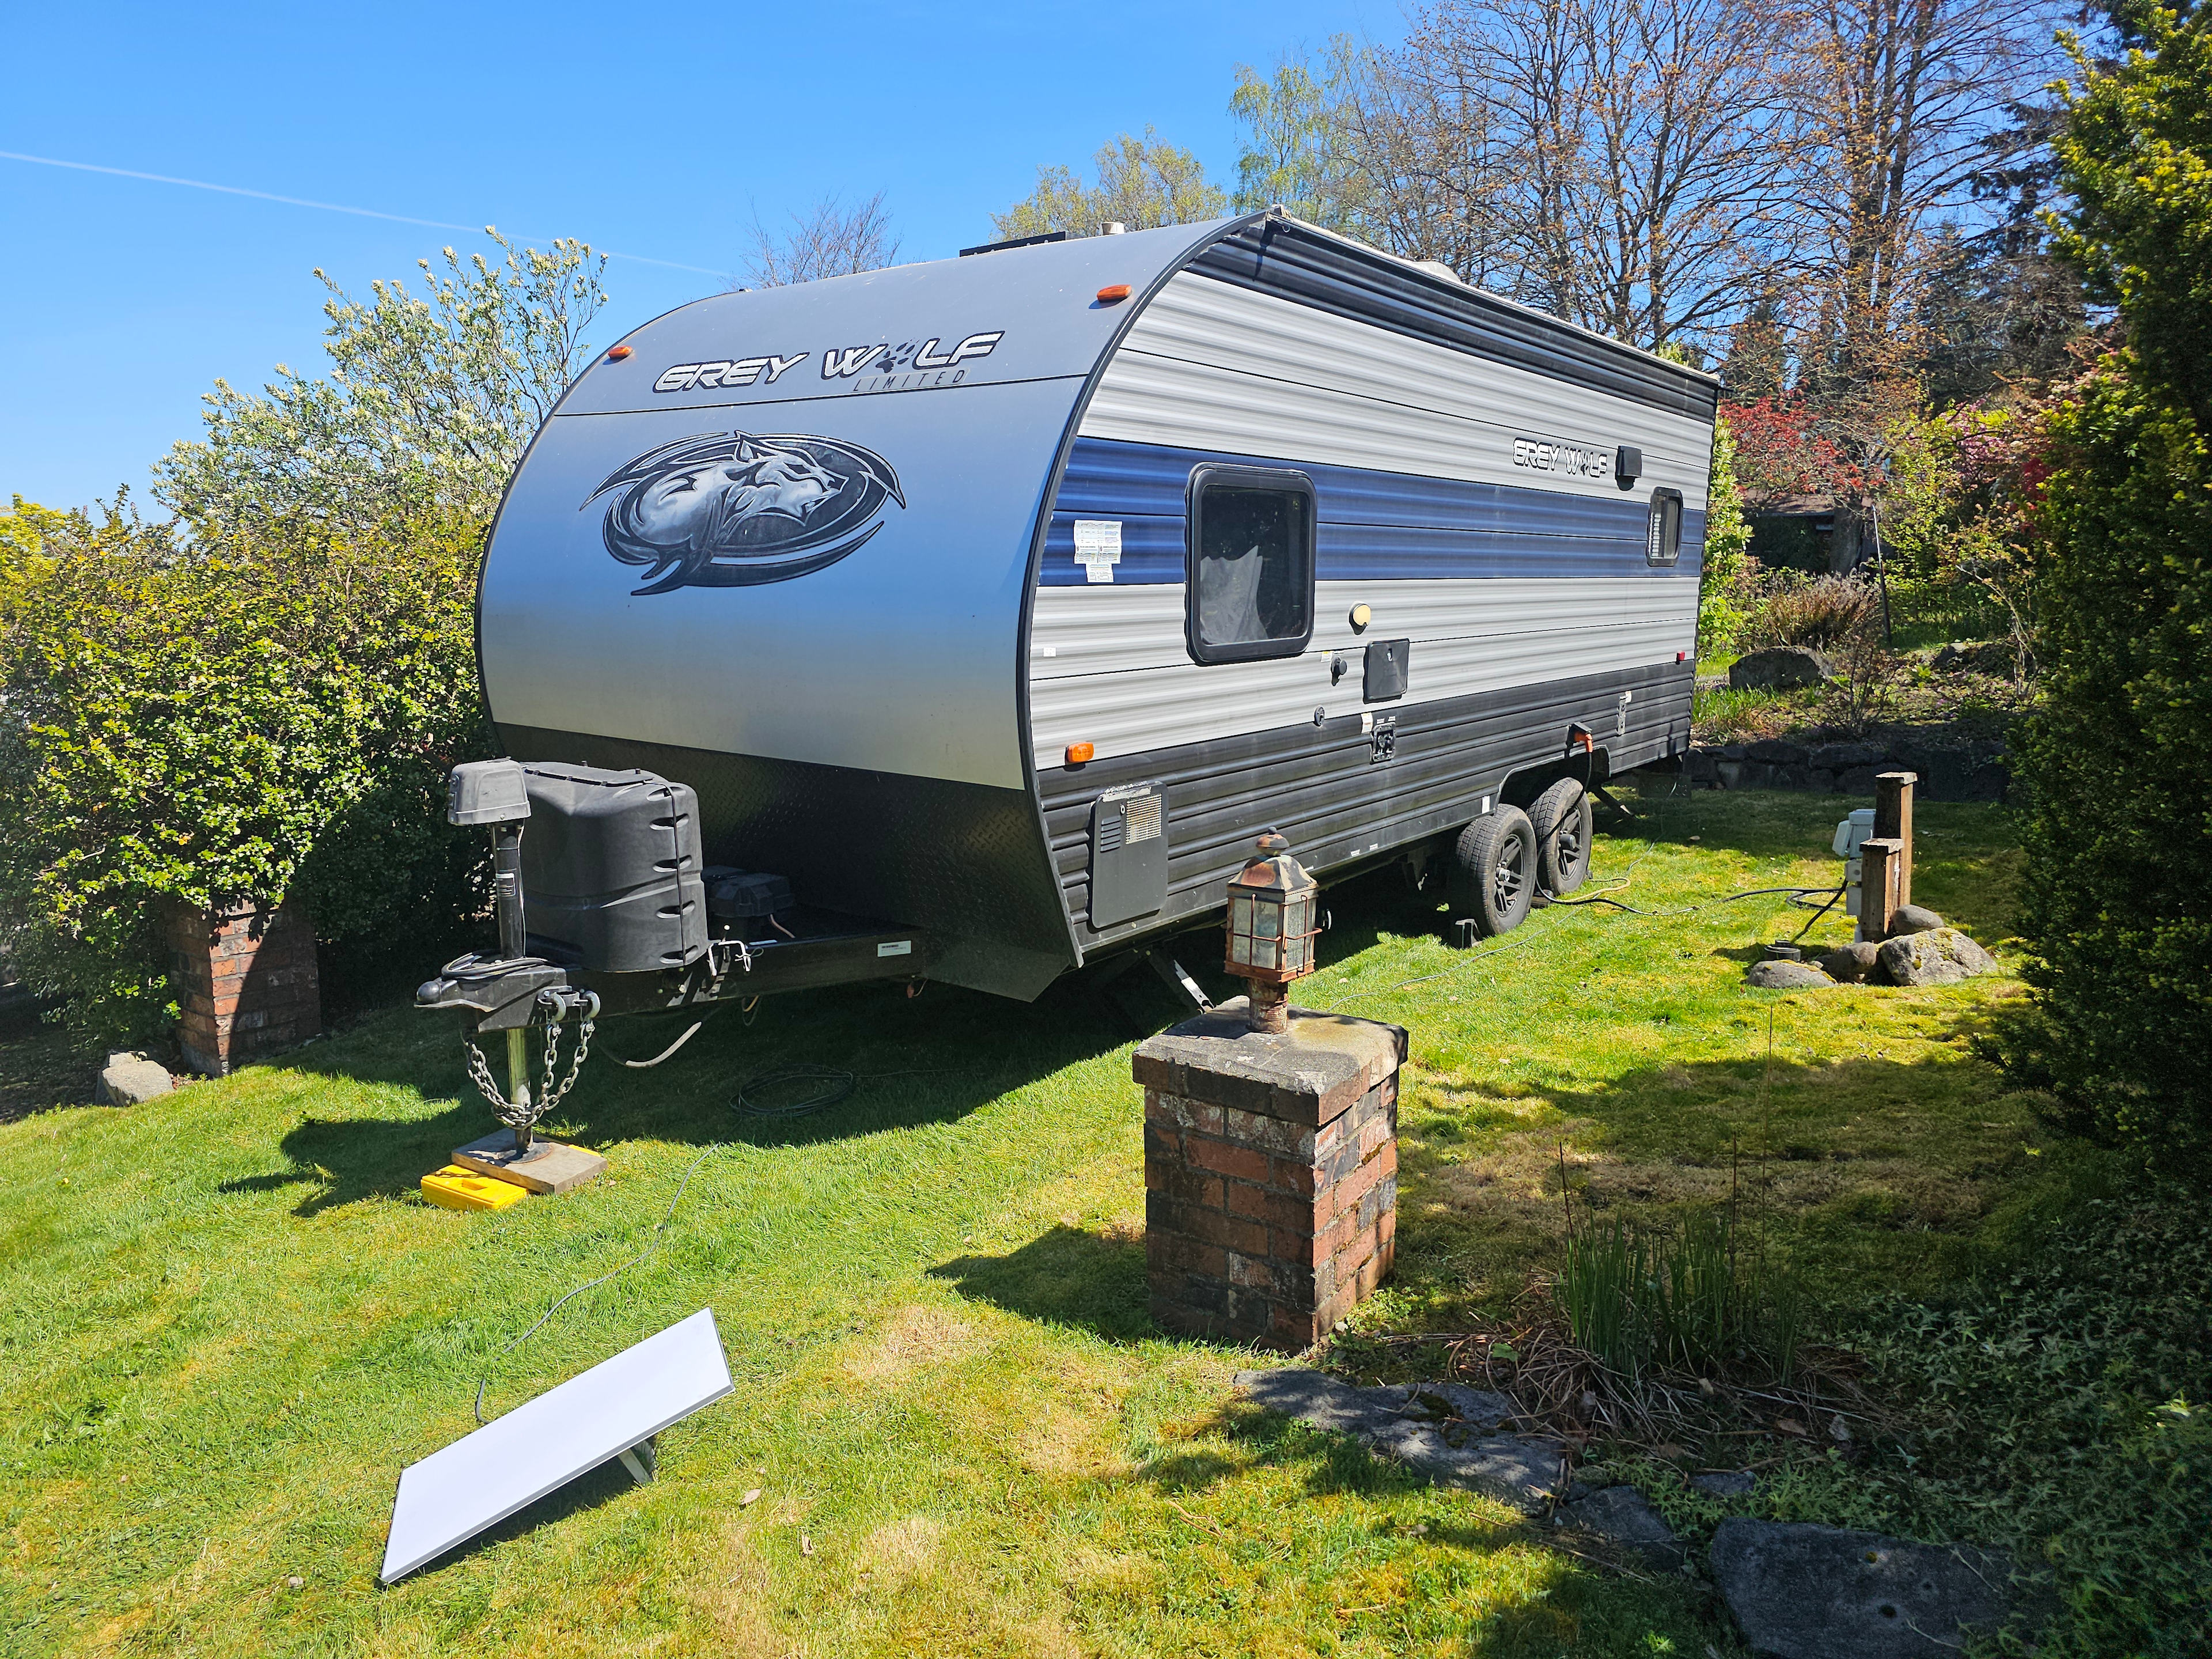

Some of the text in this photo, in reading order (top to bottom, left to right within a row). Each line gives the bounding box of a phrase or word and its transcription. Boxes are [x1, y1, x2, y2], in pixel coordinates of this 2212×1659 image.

[653, 331, 1005, 393] GREY WLF
[853, 369, 966, 392] LIMITED
[1513, 437, 1607, 478] GREY WLF
